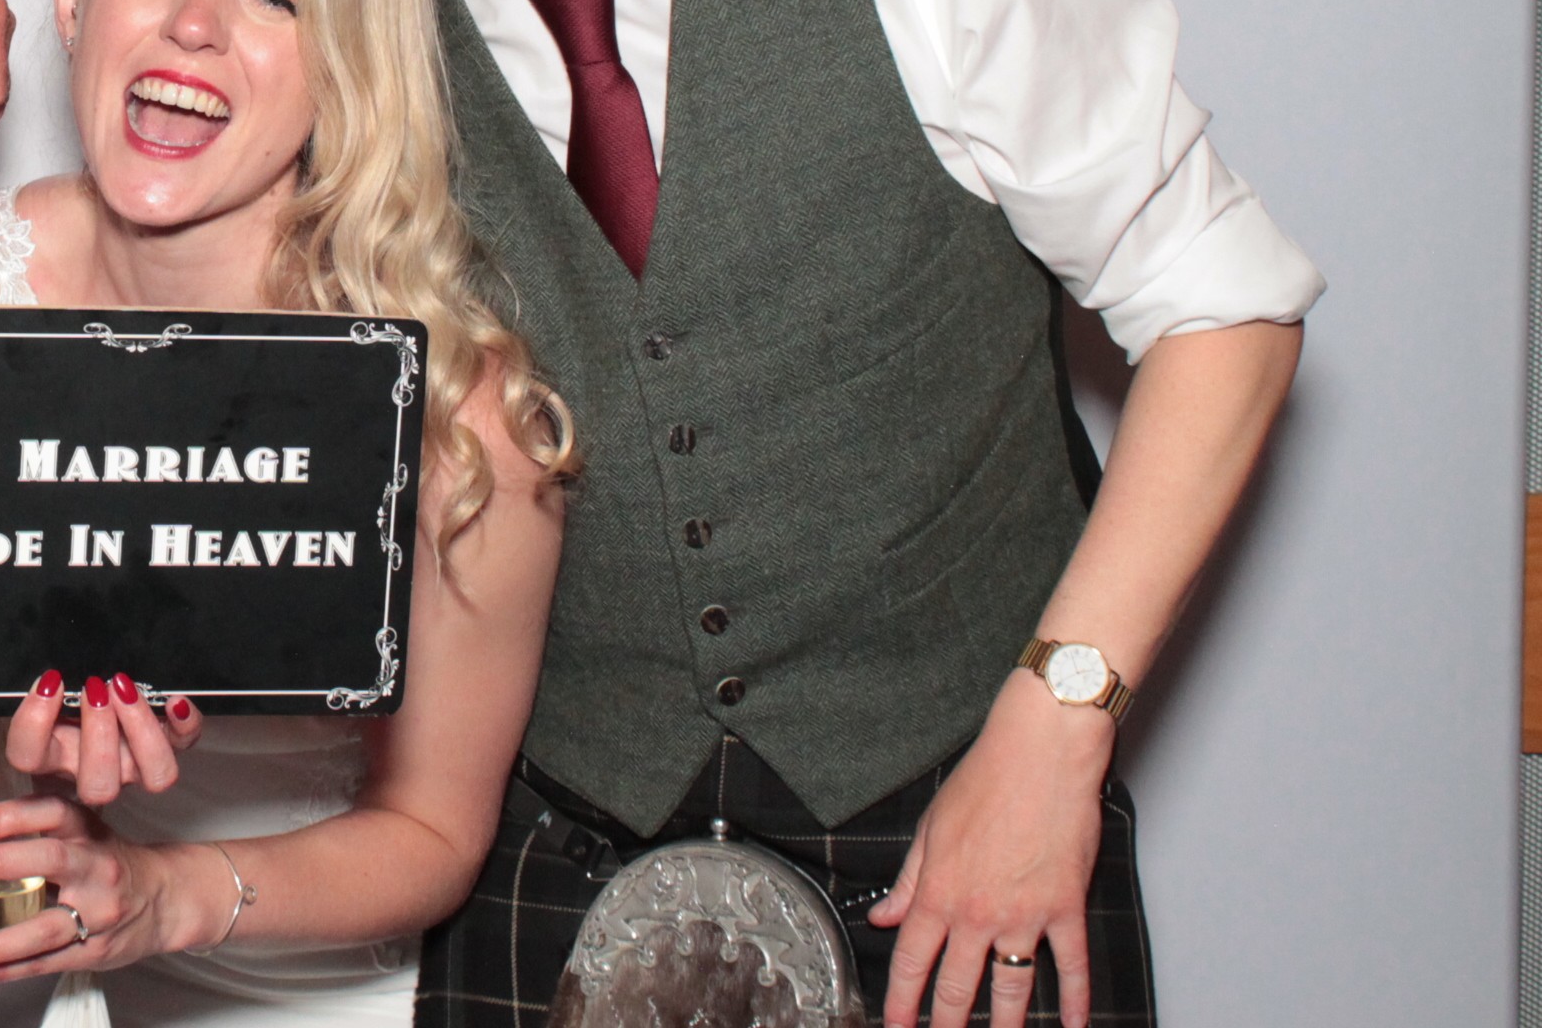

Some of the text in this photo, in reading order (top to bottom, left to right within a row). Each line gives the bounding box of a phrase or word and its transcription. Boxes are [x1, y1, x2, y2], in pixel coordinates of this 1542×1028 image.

[17, 439, 311, 483] MARRIAGE
[68, 524, 125, 568] IN
[148, 524, 357, 568] HEAVEN
